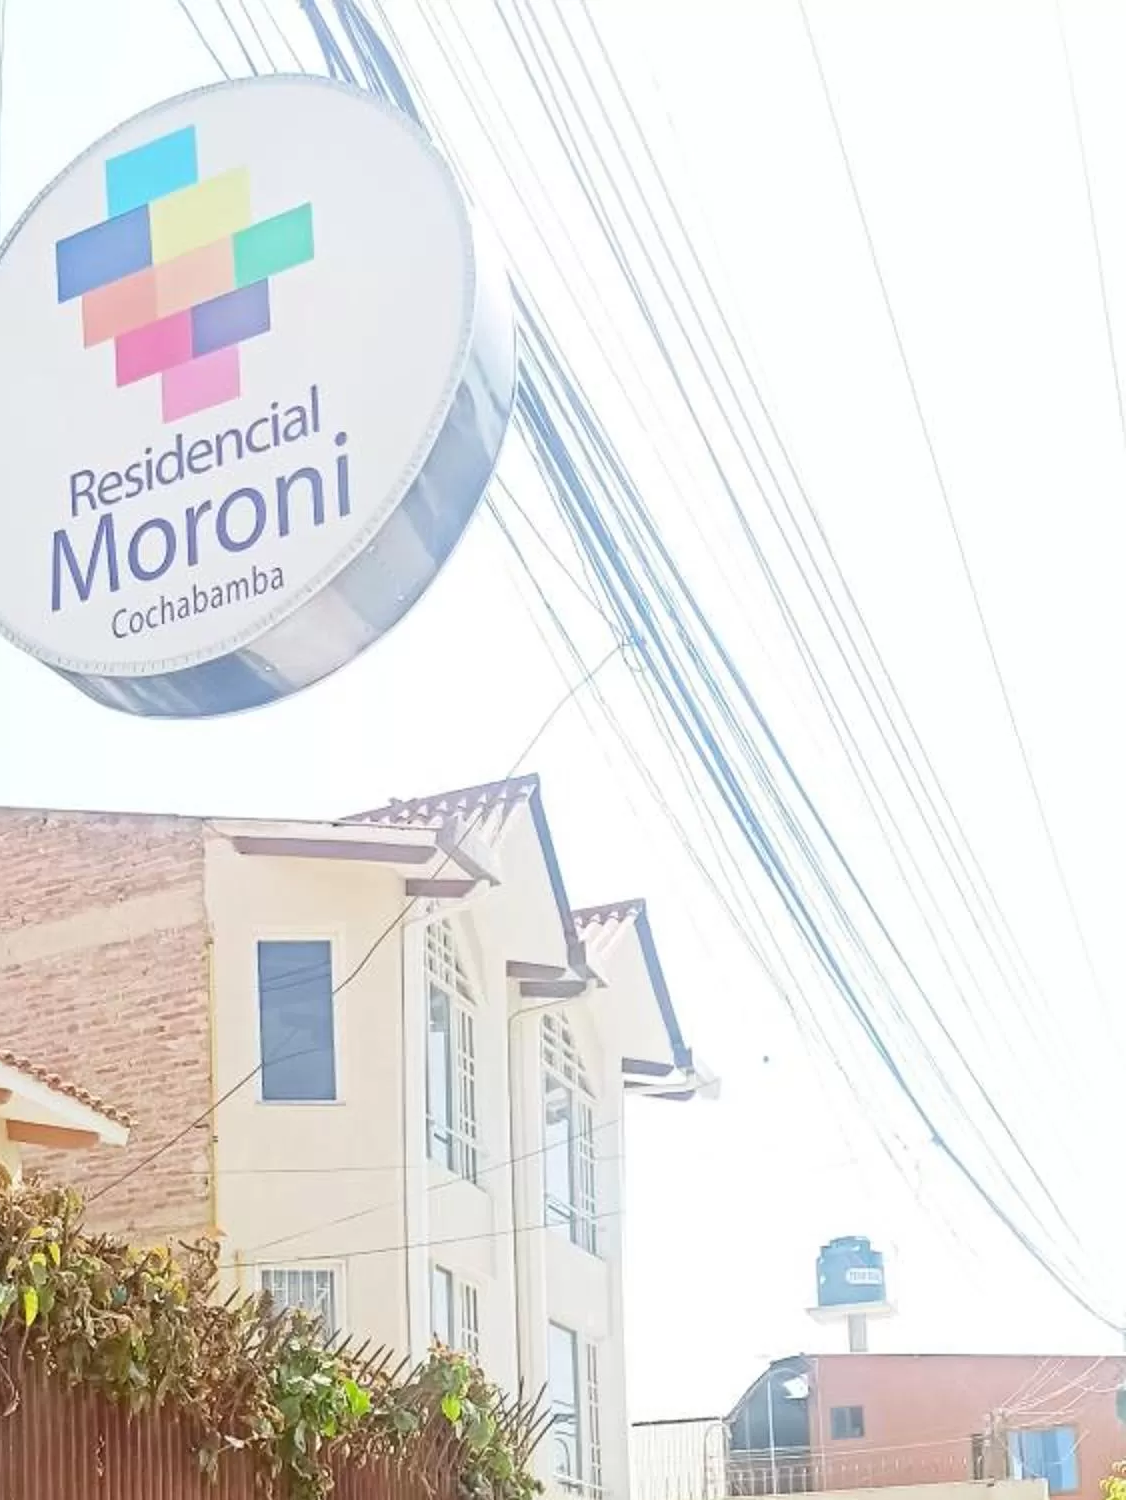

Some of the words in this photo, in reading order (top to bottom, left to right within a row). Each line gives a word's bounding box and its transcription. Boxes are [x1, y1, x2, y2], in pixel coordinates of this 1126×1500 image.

[70, 383, 320, 517] Residencial
[51, 430, 351, 613] Moroni
[110, 564, 284, 639] Cochabamba
